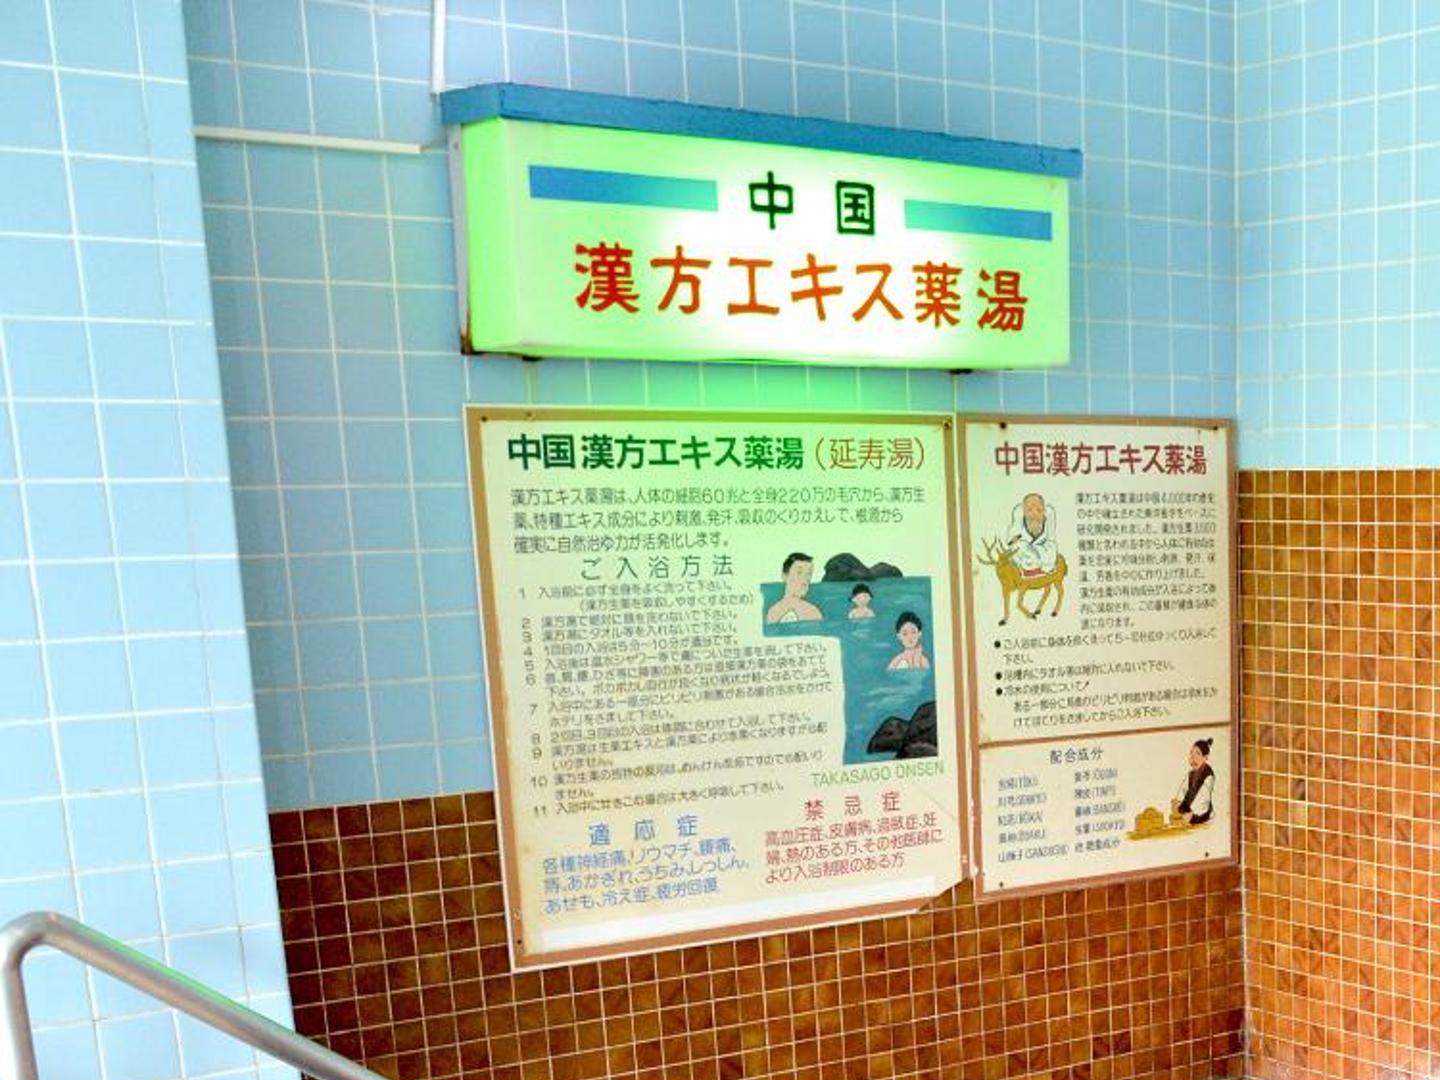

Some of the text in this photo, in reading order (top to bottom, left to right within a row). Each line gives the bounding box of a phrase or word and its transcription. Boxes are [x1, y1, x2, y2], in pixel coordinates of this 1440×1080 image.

[748, 171, 876, 236] 中国
[574, 242, 1029, 332] 漢方エキス薬湯
[814, 436, 926, 471] （延寿湯）
[994, 441, 1208, 477] 中国漢方エキス薬湯
[581, 554, 733, 580] ご入浴方法
[1049, 747, 1104, 764] 配合成分
[811, 761, 945, 788] TAKASAGO ONSEN
[803, 790, 902, 821] 禁忌症
[589, 815, 698, 847] 適応症
